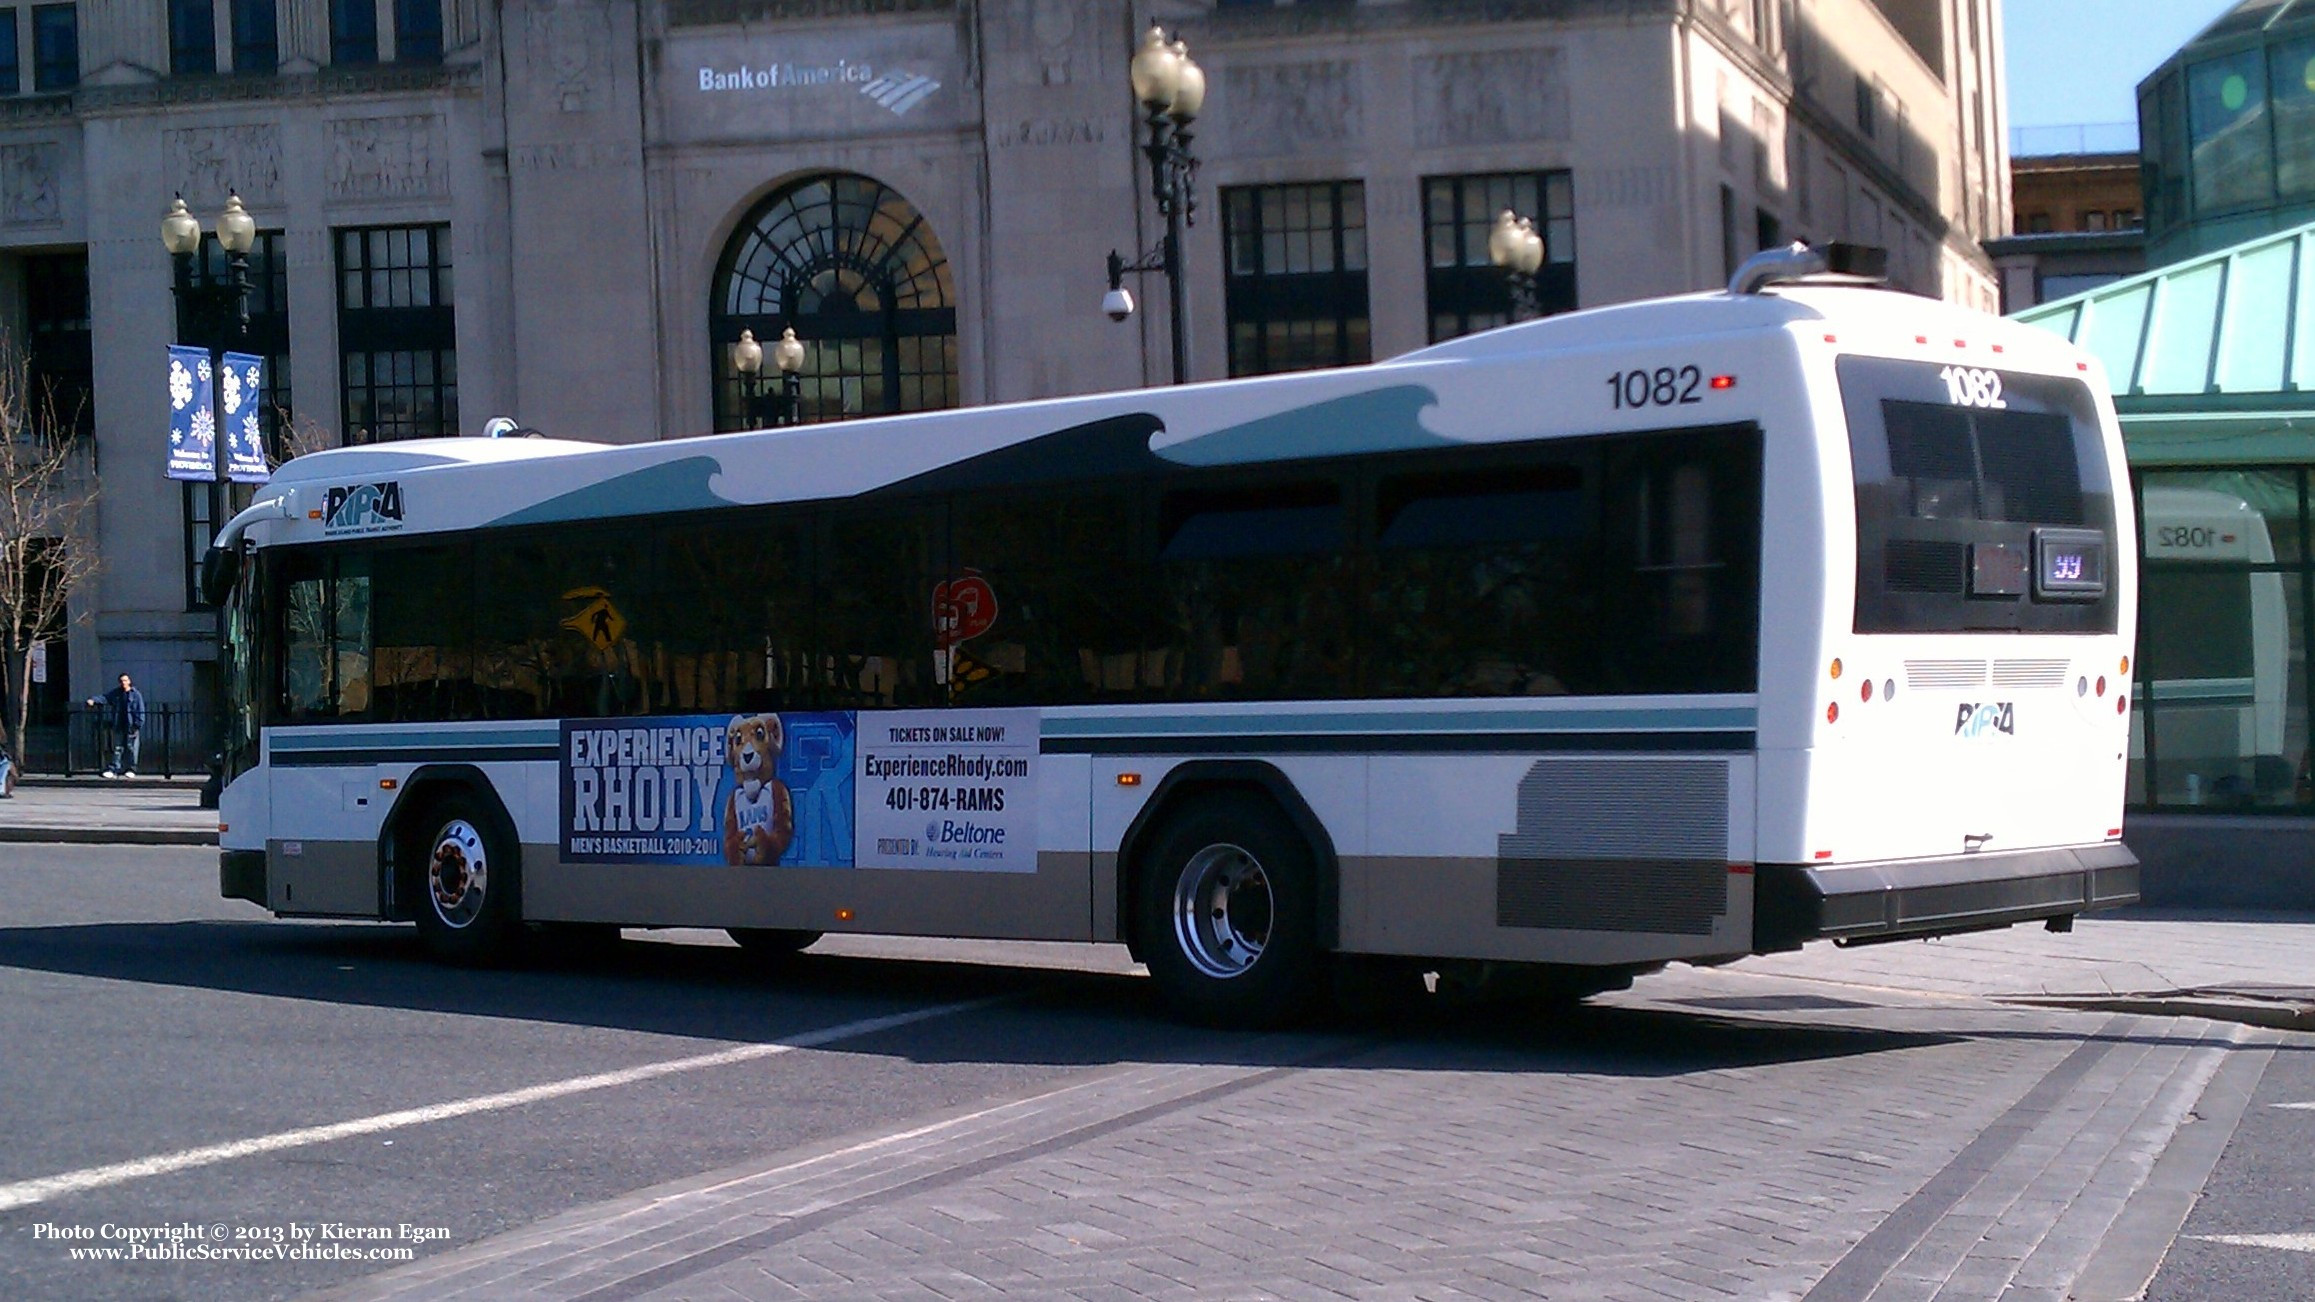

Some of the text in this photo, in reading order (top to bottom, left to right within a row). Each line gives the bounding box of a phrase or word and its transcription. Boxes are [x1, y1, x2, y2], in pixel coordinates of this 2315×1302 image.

[700, 58, 873, 91] Bank of America
[1607, 364, 1703, 409] 1082
[1939, 365, 2007, 409] 1082
[325, 481, 403, 528] RIPTA
[889, 726, 1005, 743] TICKETS ON SALE NOW!
[1954, 702, 2014, 738] RIPTA
[571, 727, 725, 767] EXPERIENCE
[865, 754, 1028, 781] ExperienceRhody.com
[573, 765, 721, 831] RHODY
[886, 787, 1005, 811] 401-874-RAMS
[571, 838, 718, 855] MEN'S BASKETBALL 2010-2011
[941, 820, 1005, 844] Beltone
[926, 847, 957, 860] Hearing
[973, 848, 1003, 859] Centers
